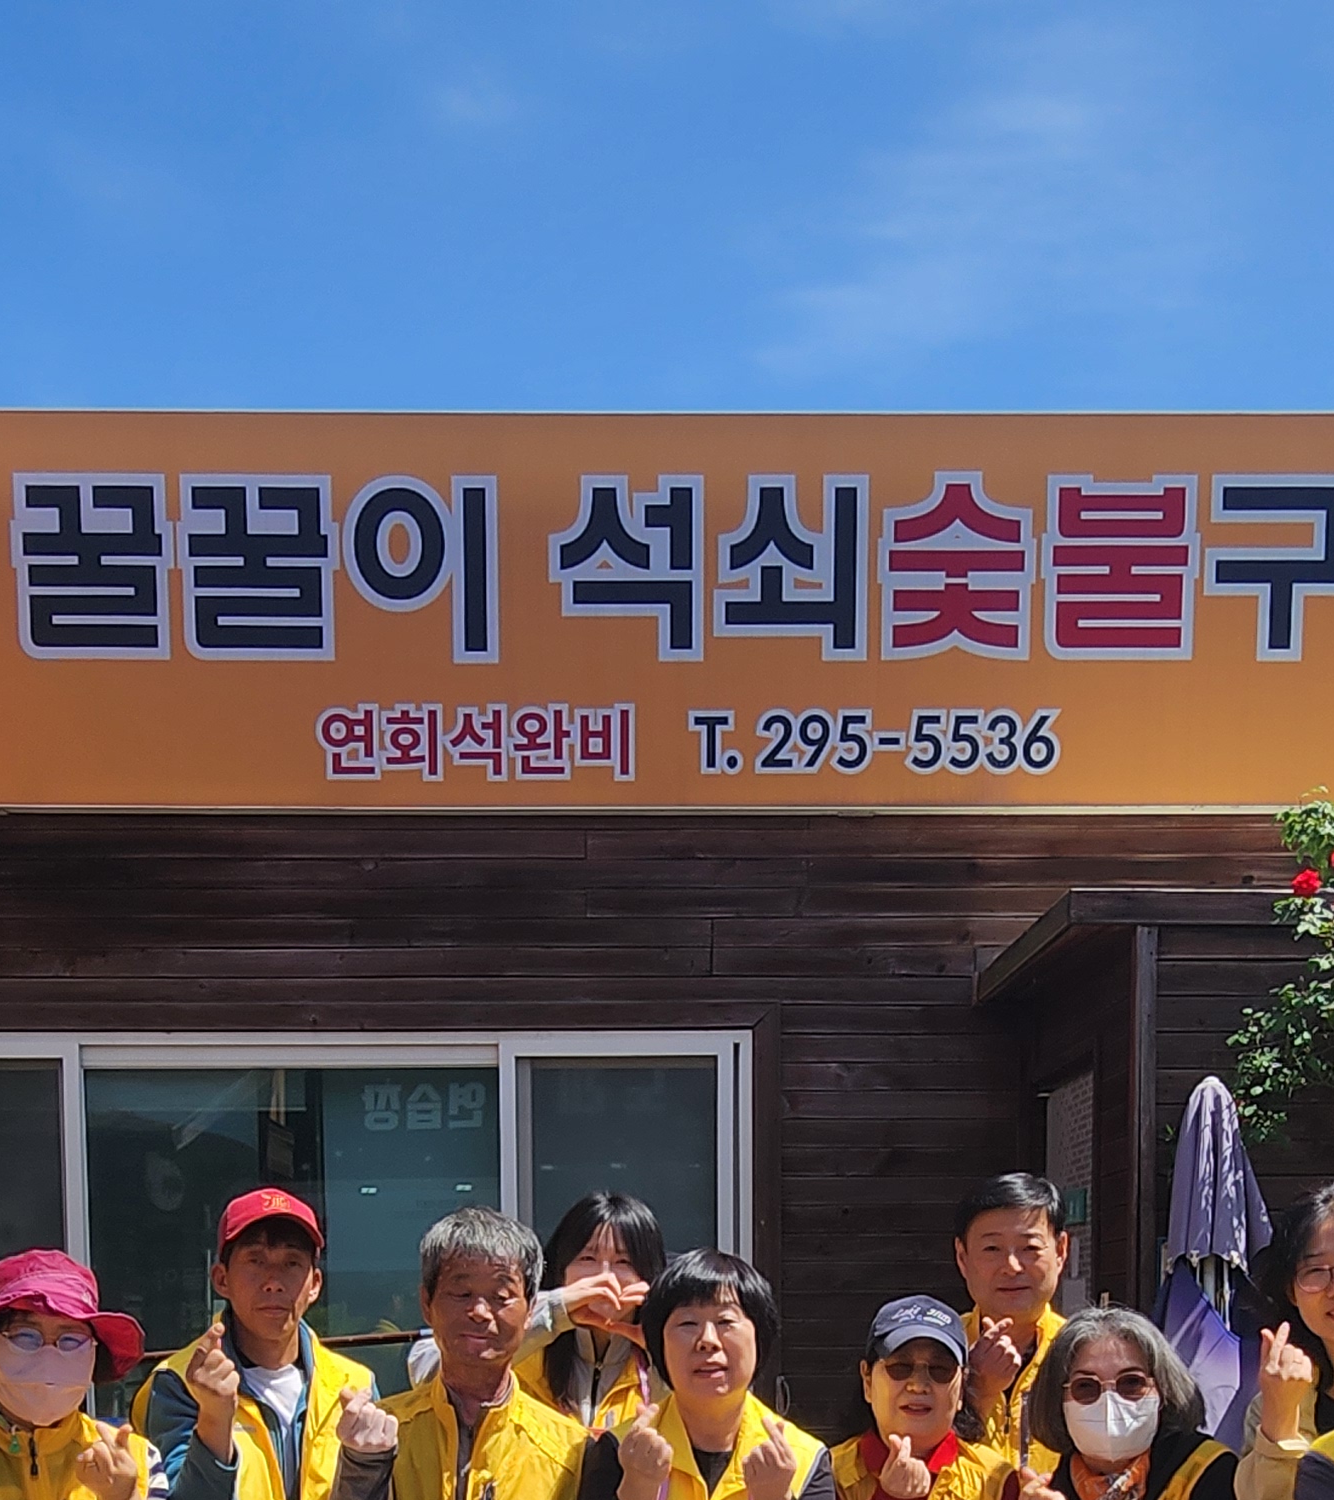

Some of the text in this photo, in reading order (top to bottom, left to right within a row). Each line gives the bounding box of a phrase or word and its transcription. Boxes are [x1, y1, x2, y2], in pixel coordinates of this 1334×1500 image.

[13, 473, 498, 663] 꿀꿀이
[317, 703, 636, 782] 연회석완비
[690, 706, 1061, 774] T. 295-5536
